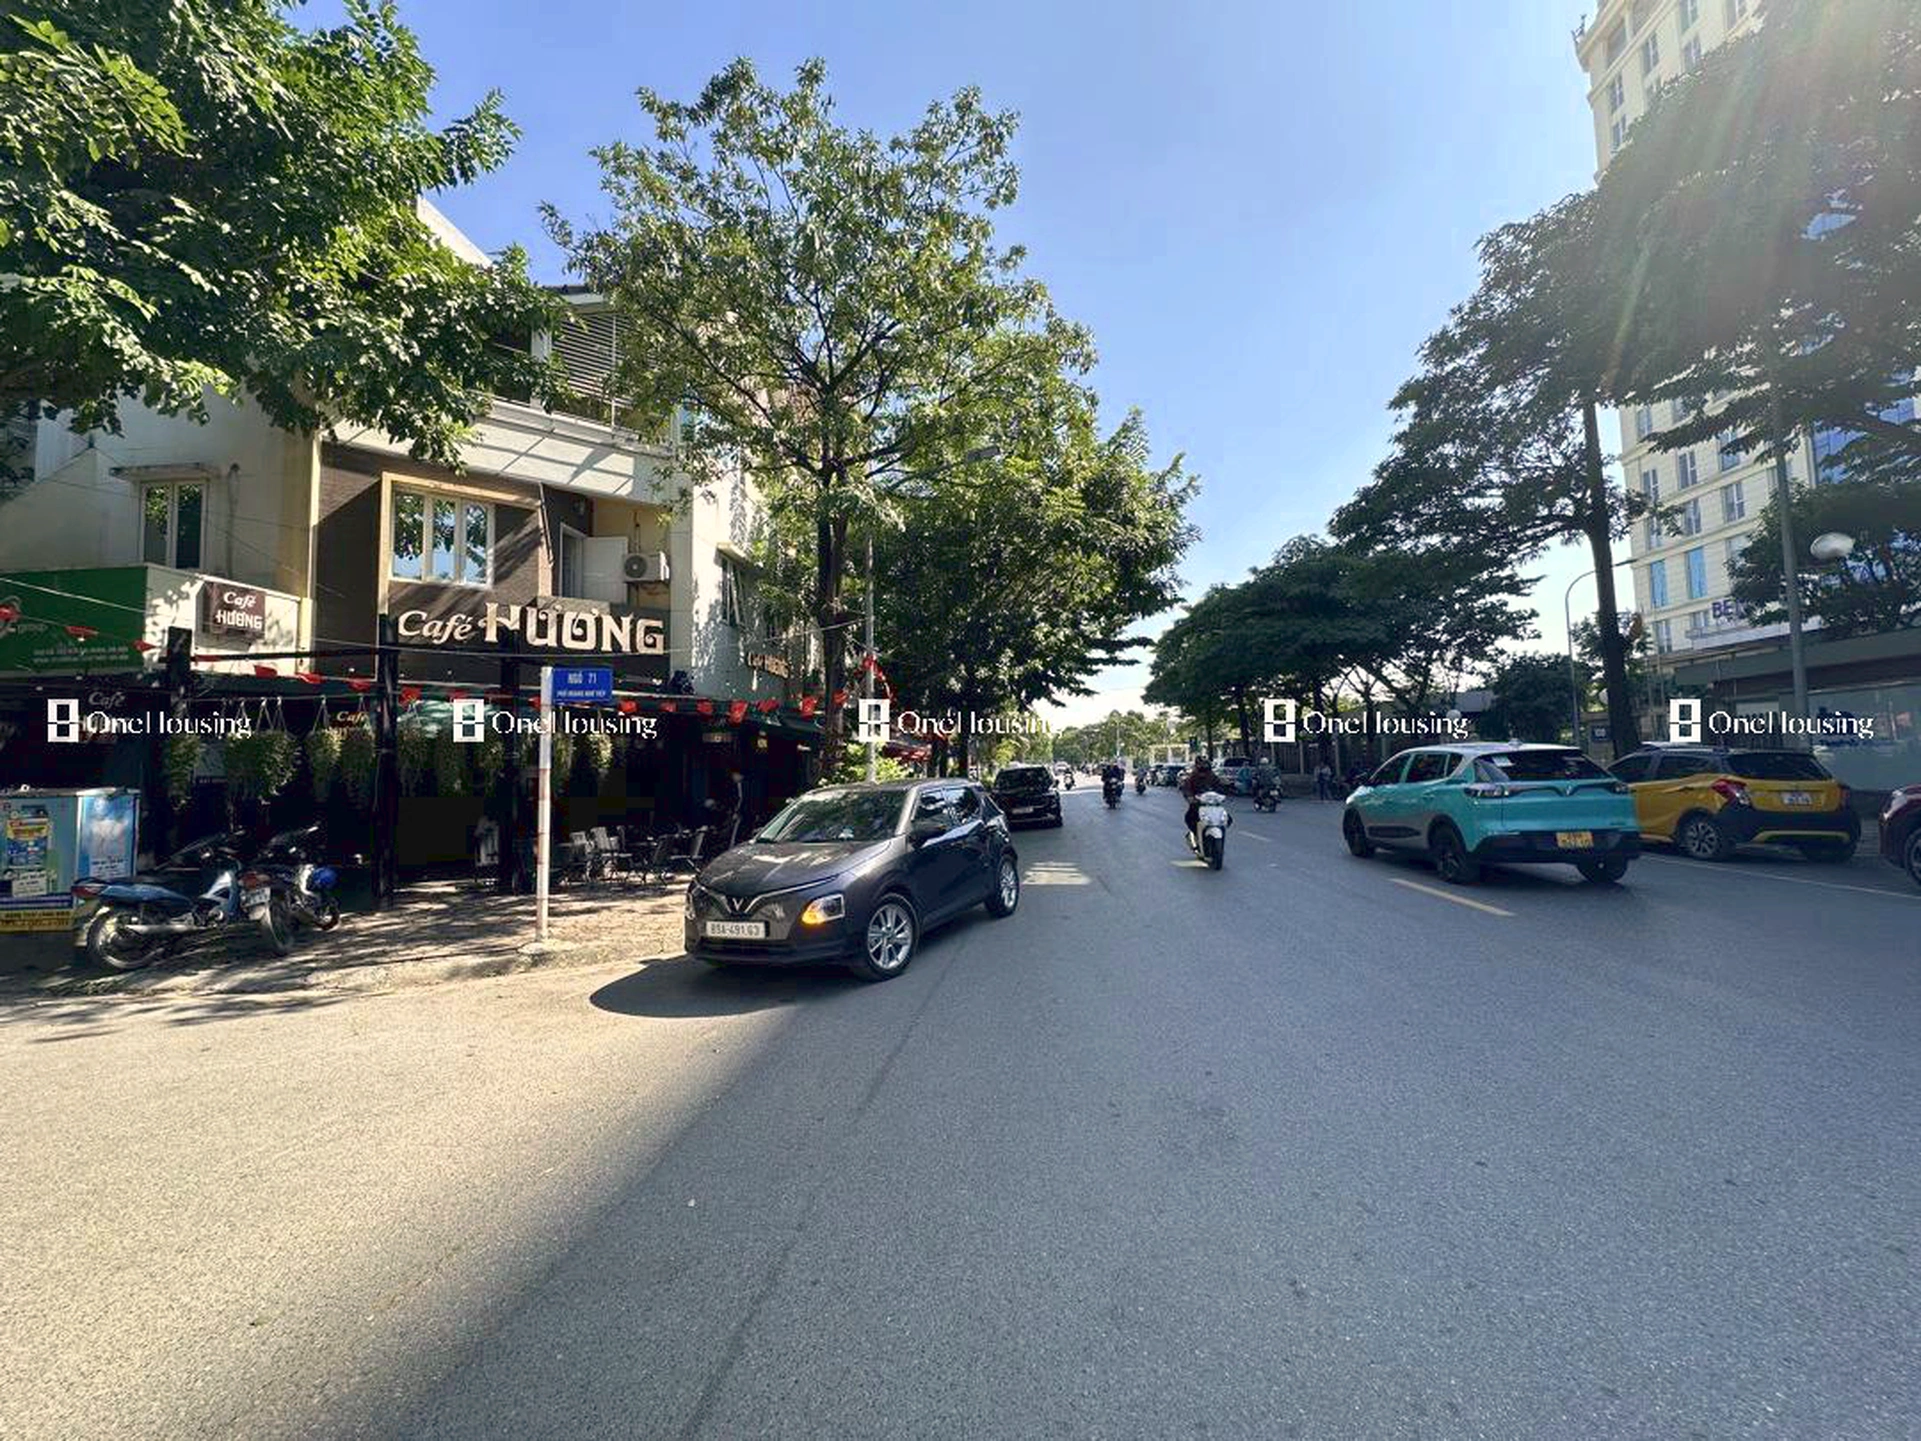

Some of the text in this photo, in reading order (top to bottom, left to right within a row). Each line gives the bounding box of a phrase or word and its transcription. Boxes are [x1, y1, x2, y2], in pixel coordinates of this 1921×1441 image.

[223, 590, 257, 609] Café
[215, 609, 263, 630] HƯƠNG
[398, 602, 665, 655] Café HƯƠNG
[588, 672, 597, 684] 71
[88, 690, 126, 709] Café
